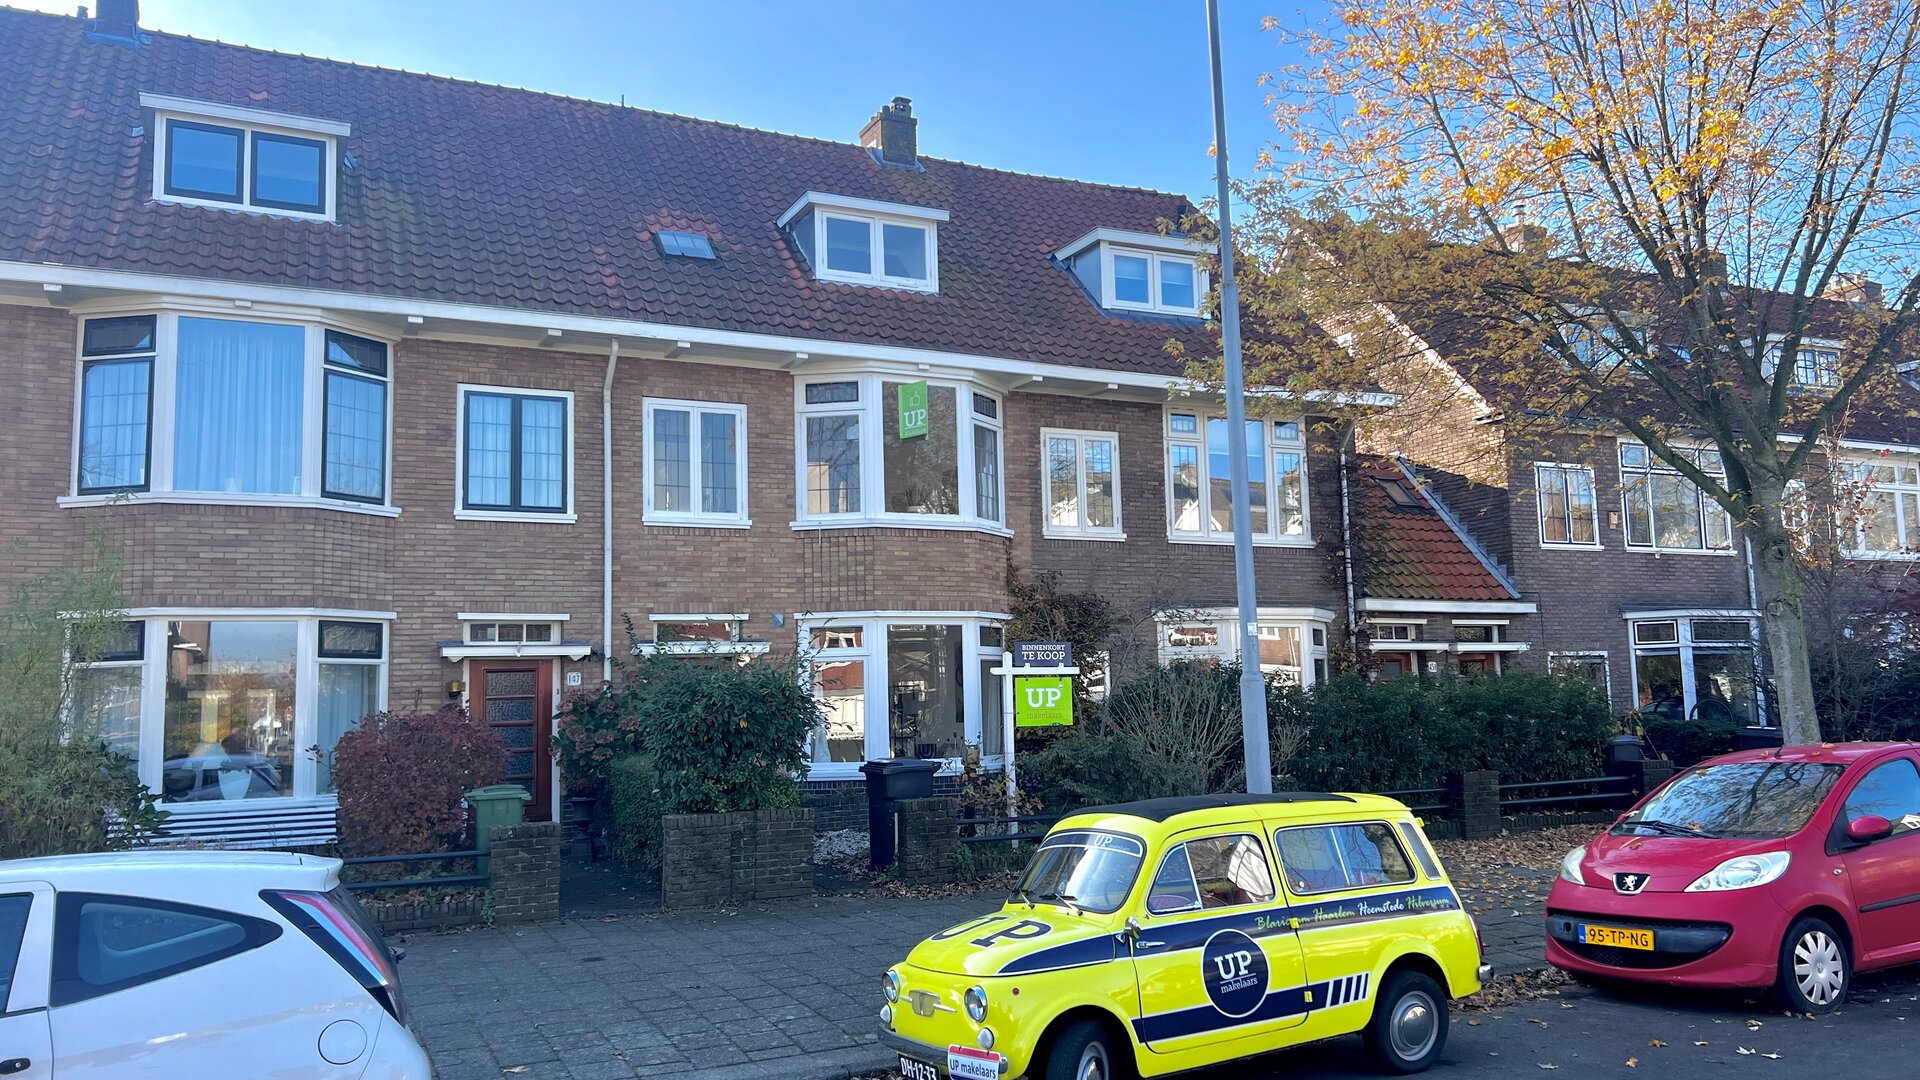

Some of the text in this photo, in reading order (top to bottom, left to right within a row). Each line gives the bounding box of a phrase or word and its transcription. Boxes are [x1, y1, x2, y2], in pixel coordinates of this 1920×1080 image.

[903, 409, 926, 428] UP
[1022, 651, 1066, 660] TE KOOP
[1025, 688, 1062, 708] UP
[1093, 835, 1113, 847] UP
[1313, 905, 1355, 922] Haarlem
[1357, 898, 1405, 917] Heemstede
[1406, 895, 1450, 910] Hilversum
[931, 916, 1052, 948] UP
[1589, 928, 1649, 947] 95-TP-NG
[1213, 950, 1252, 980] UP
[1220, 977, 1258, 994] makelaars
[949, 1058, 997, 1079] UP makelaars
